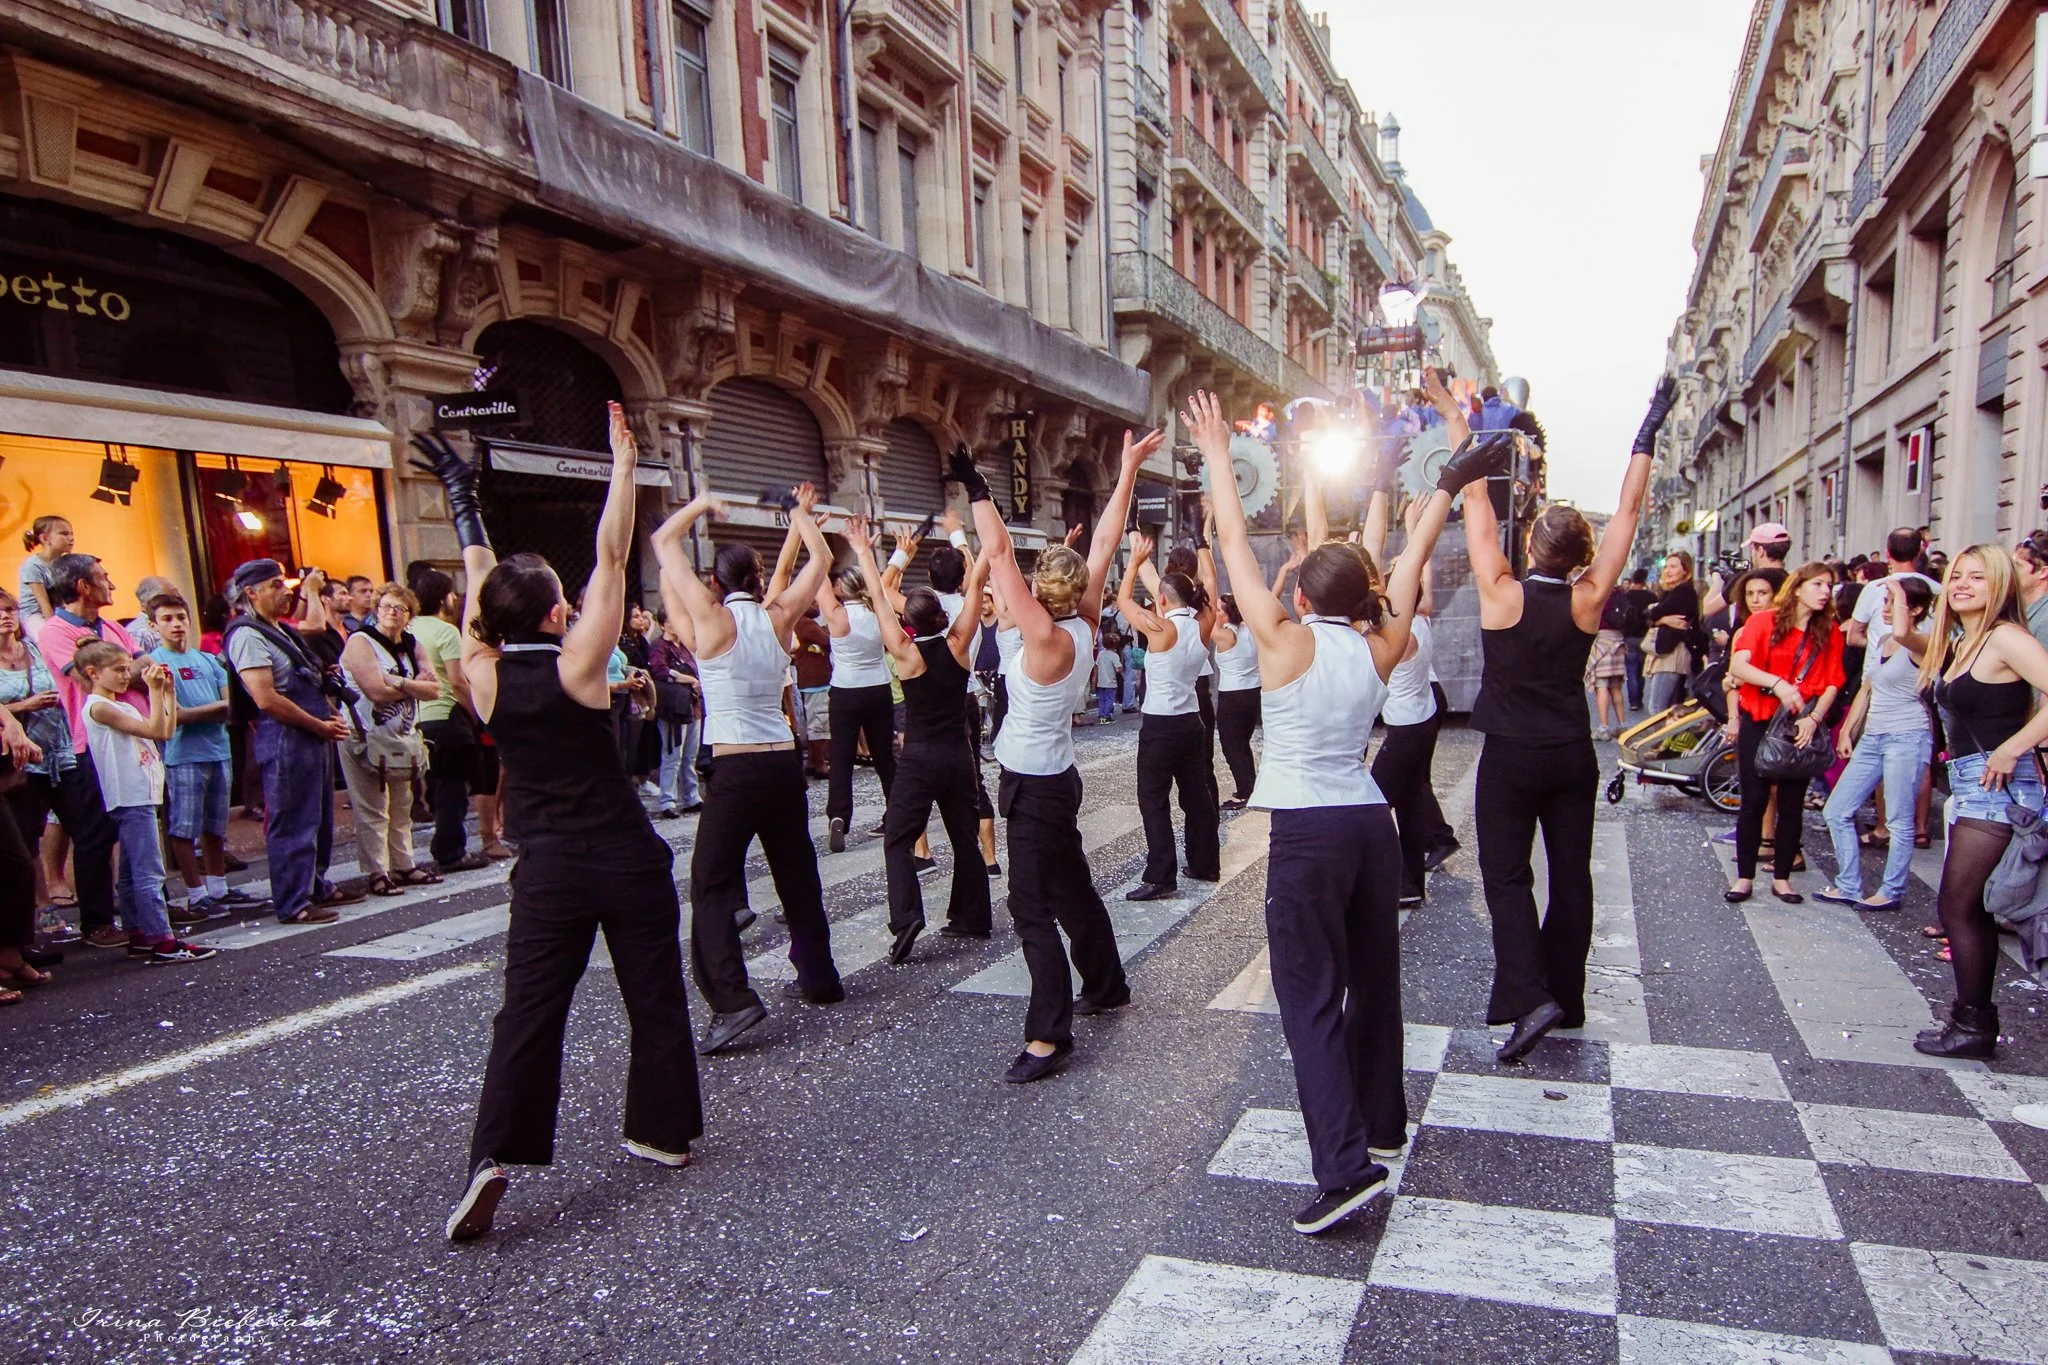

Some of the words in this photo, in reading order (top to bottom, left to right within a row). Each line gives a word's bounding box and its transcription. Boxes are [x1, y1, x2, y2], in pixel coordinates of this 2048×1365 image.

[0, 272, 131, 321] etto
[438, 402, 517, 419] Centreville
[556, 460, 613, 478] Centrevill
[1011, 419, 1029, 514] HANDY
